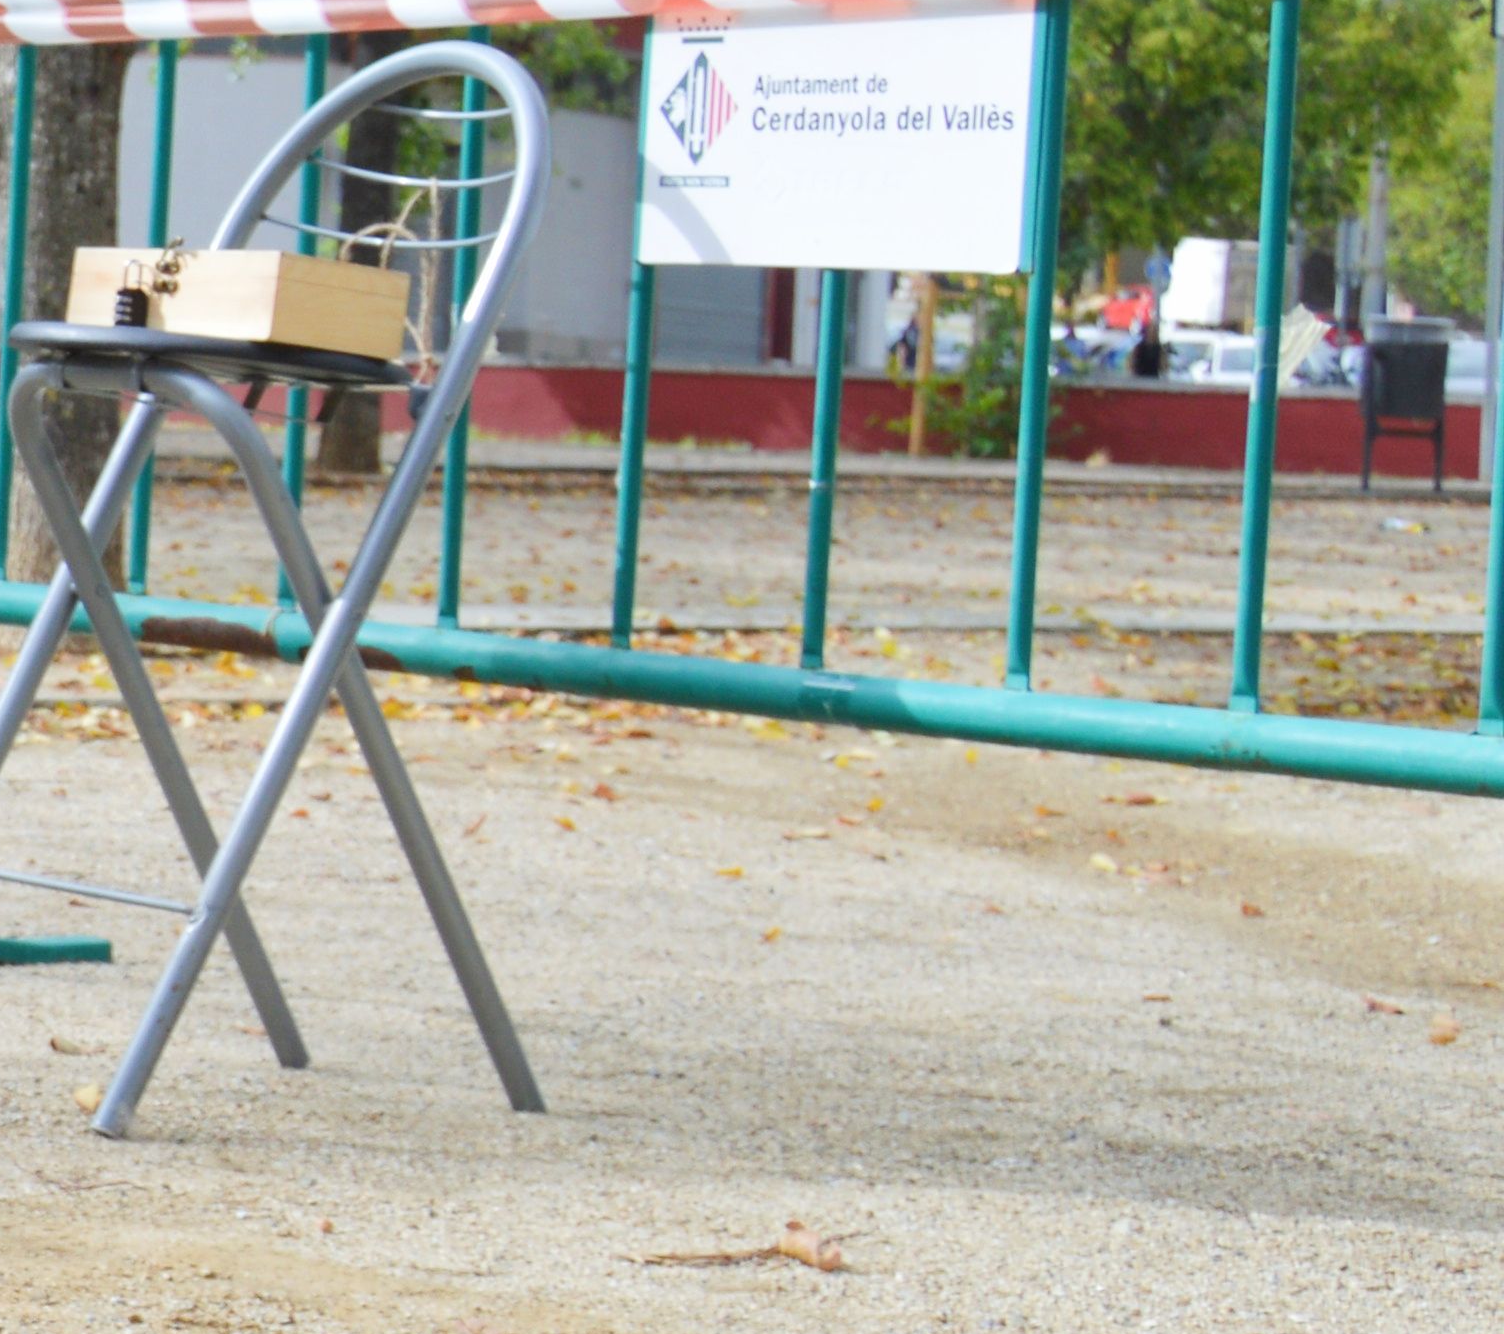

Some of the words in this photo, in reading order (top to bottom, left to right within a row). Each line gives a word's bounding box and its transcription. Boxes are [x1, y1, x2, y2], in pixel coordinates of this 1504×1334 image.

[754, 75, 859, 100] Ajuntament
[866, 74, 888, 94] de
[752, 106, 886, 137] Cerdanyola
[897, 105, 932, 131] del
[943, 103, 1015, 131] Vallès
